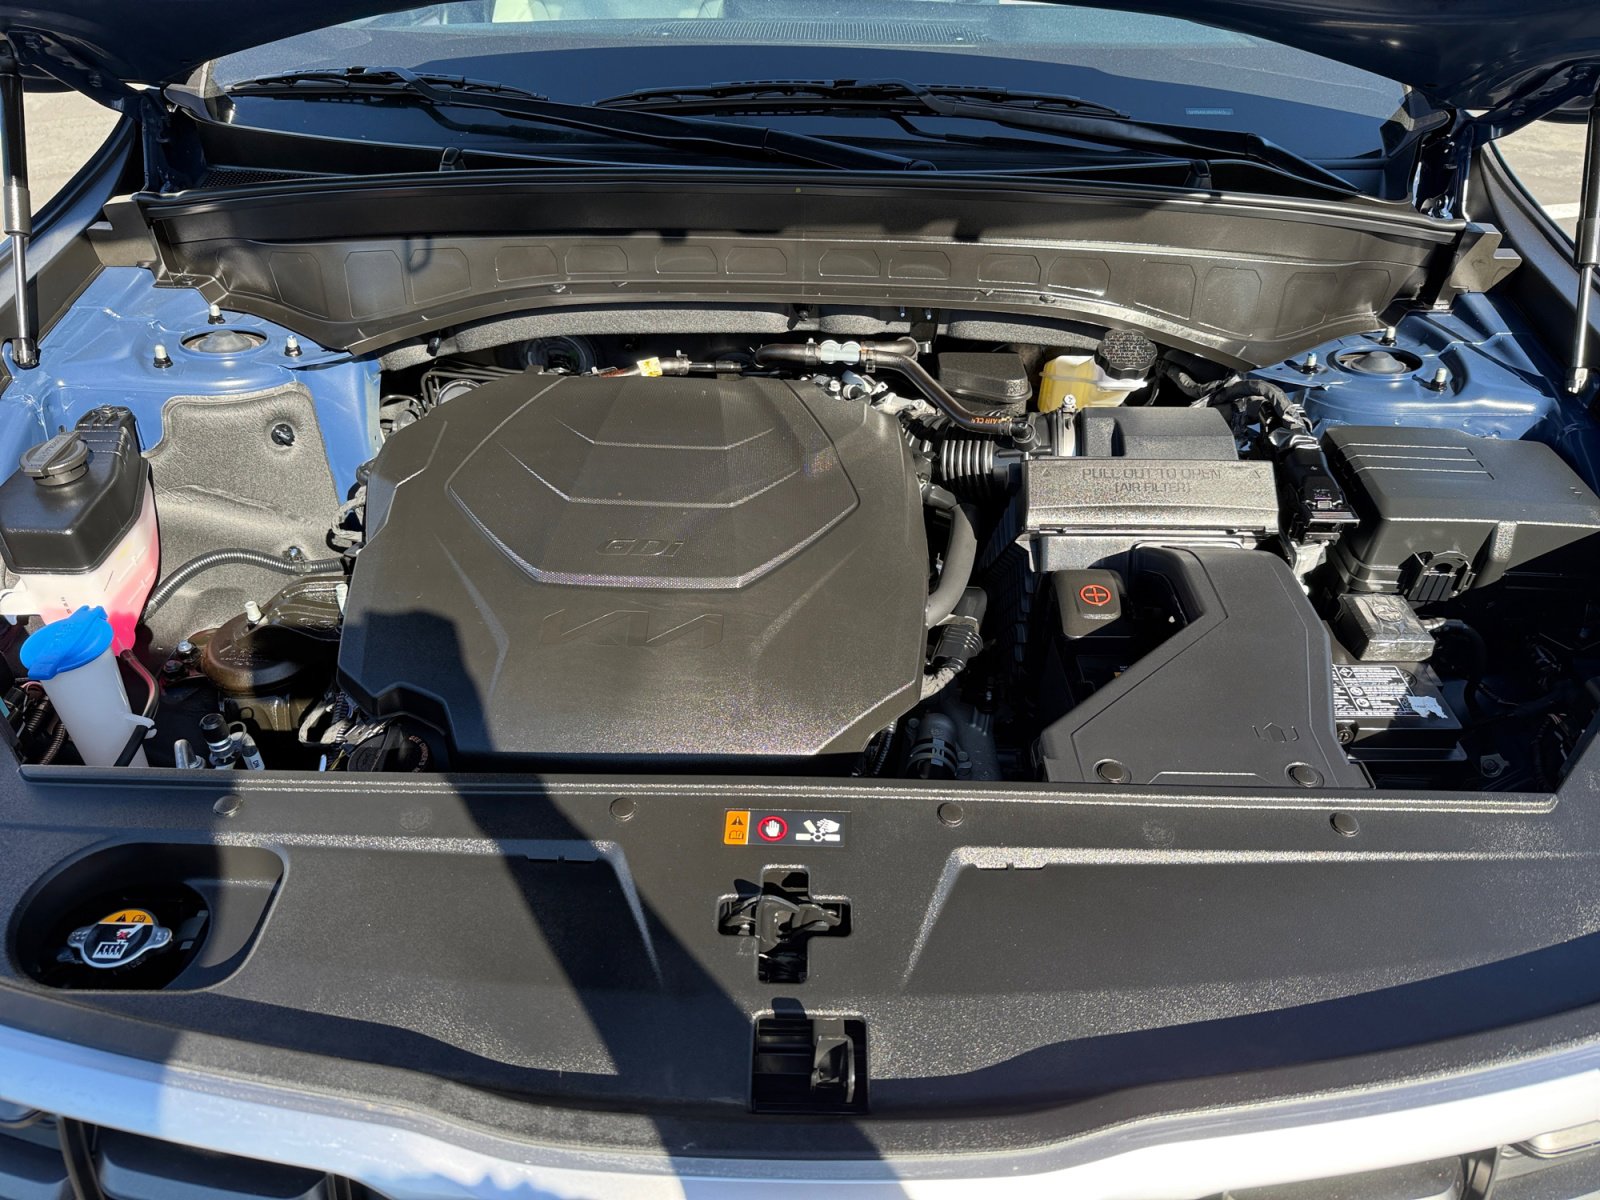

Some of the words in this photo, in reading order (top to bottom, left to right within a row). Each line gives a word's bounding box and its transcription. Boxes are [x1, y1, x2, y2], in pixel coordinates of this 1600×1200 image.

[1082, 468, 1120, 480] PULL
[1123, 468, 1151, 480] OUT
[1155, 468, 1177, 480] TO
[1181, 469, 1221, 480] OPEN
